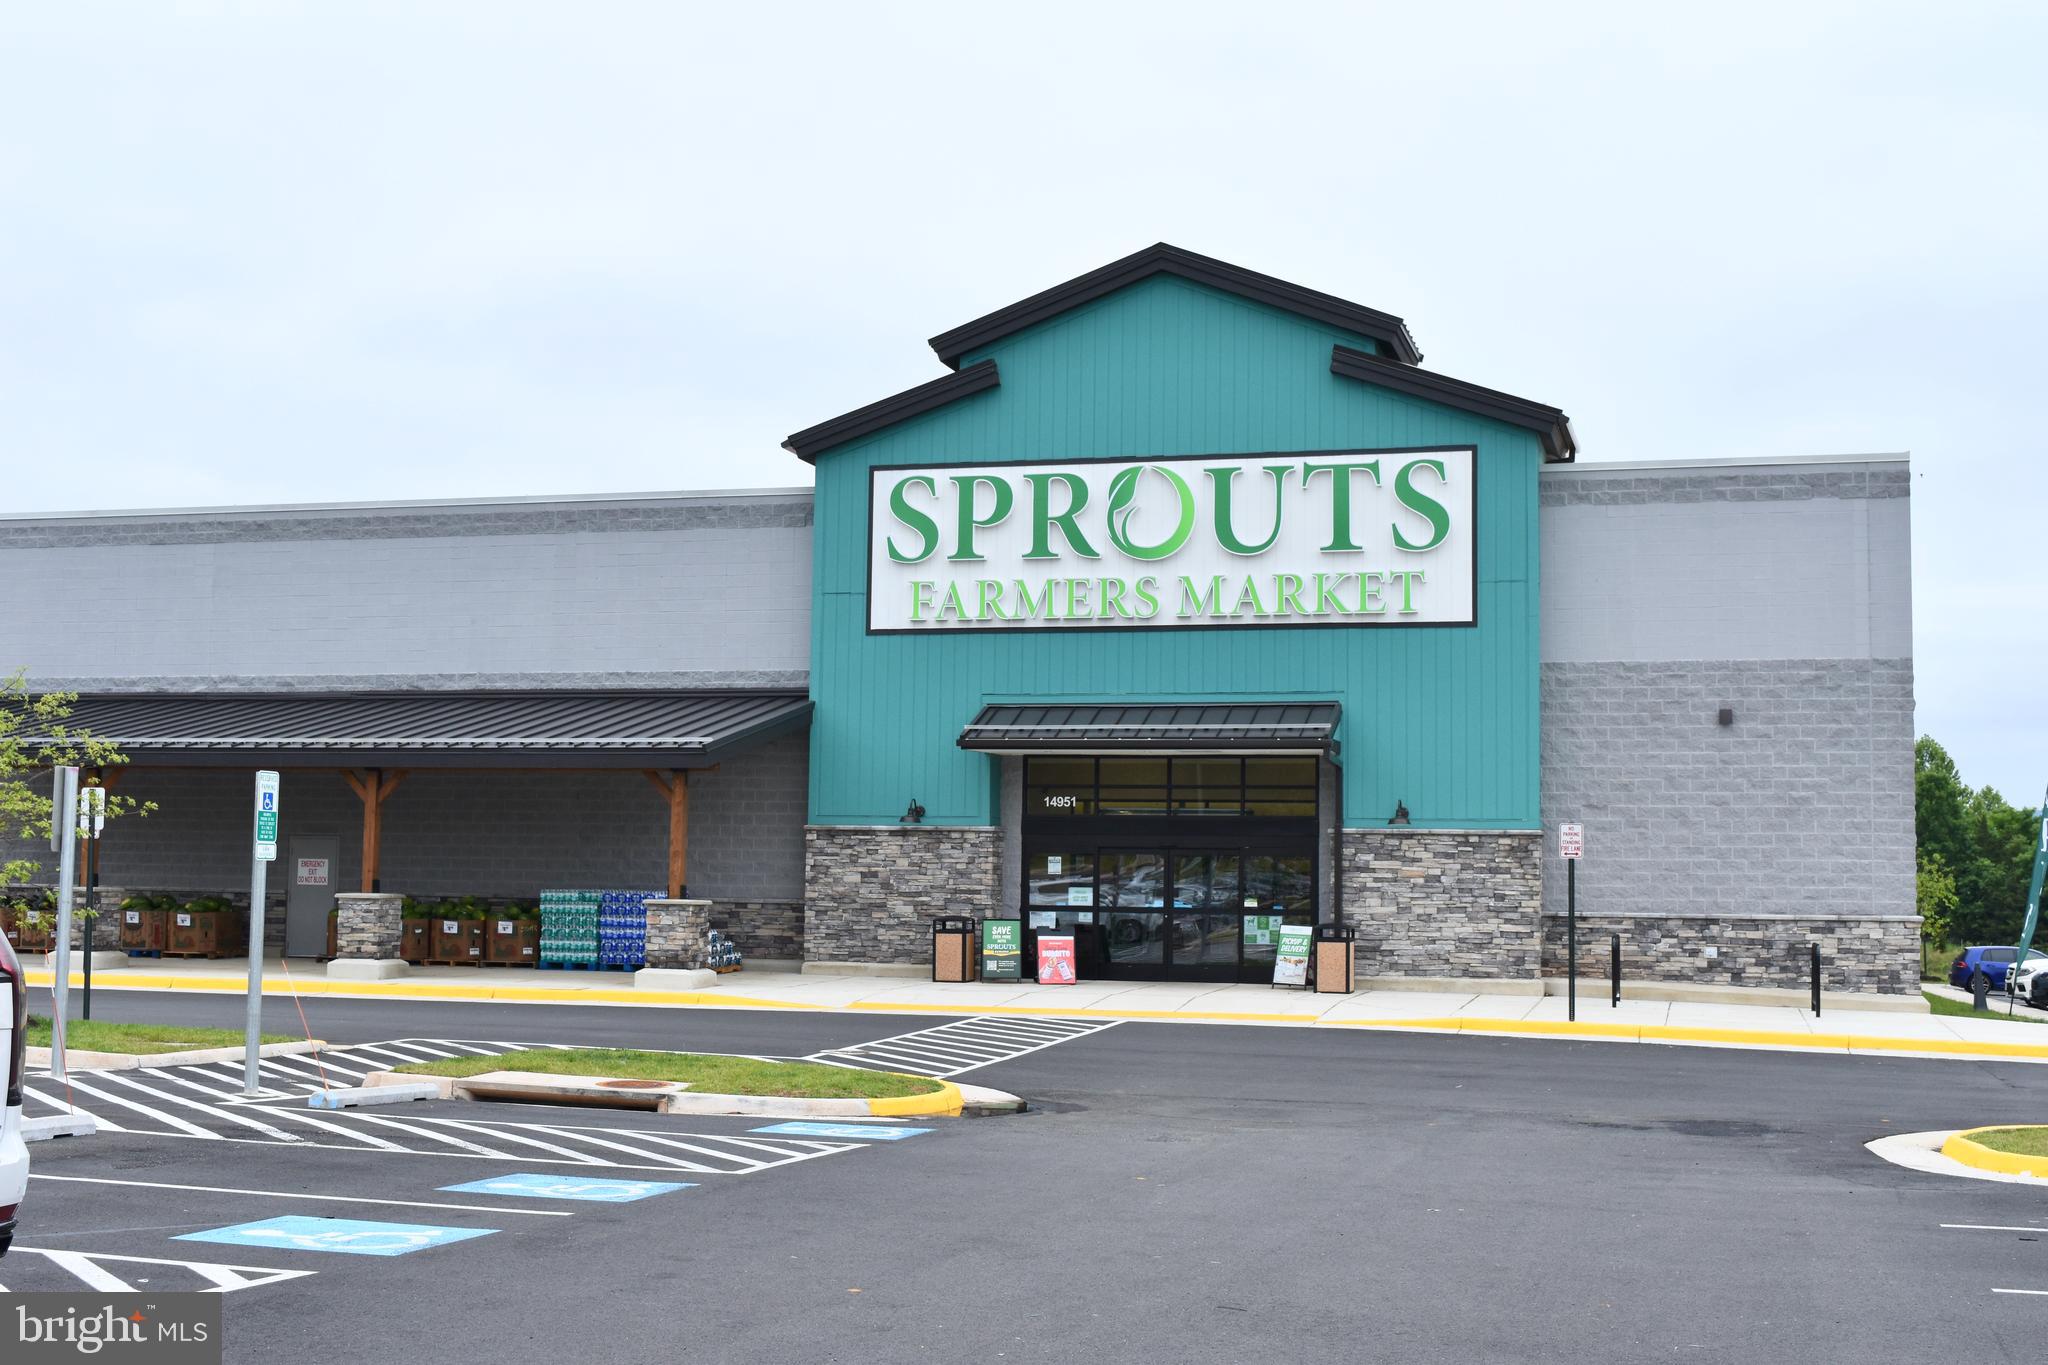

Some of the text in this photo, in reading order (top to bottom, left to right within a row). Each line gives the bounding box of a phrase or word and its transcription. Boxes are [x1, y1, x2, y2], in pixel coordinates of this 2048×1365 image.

[887, 459, 1451, 564] SPROUTS
[908, 570, 1426, 622] FARMERS MARKET
[1043, 796, 1076, 807] 14951
[992, 926, 1012, 935] SAVE
[1281, 937, 1302, 945] PICKUP
